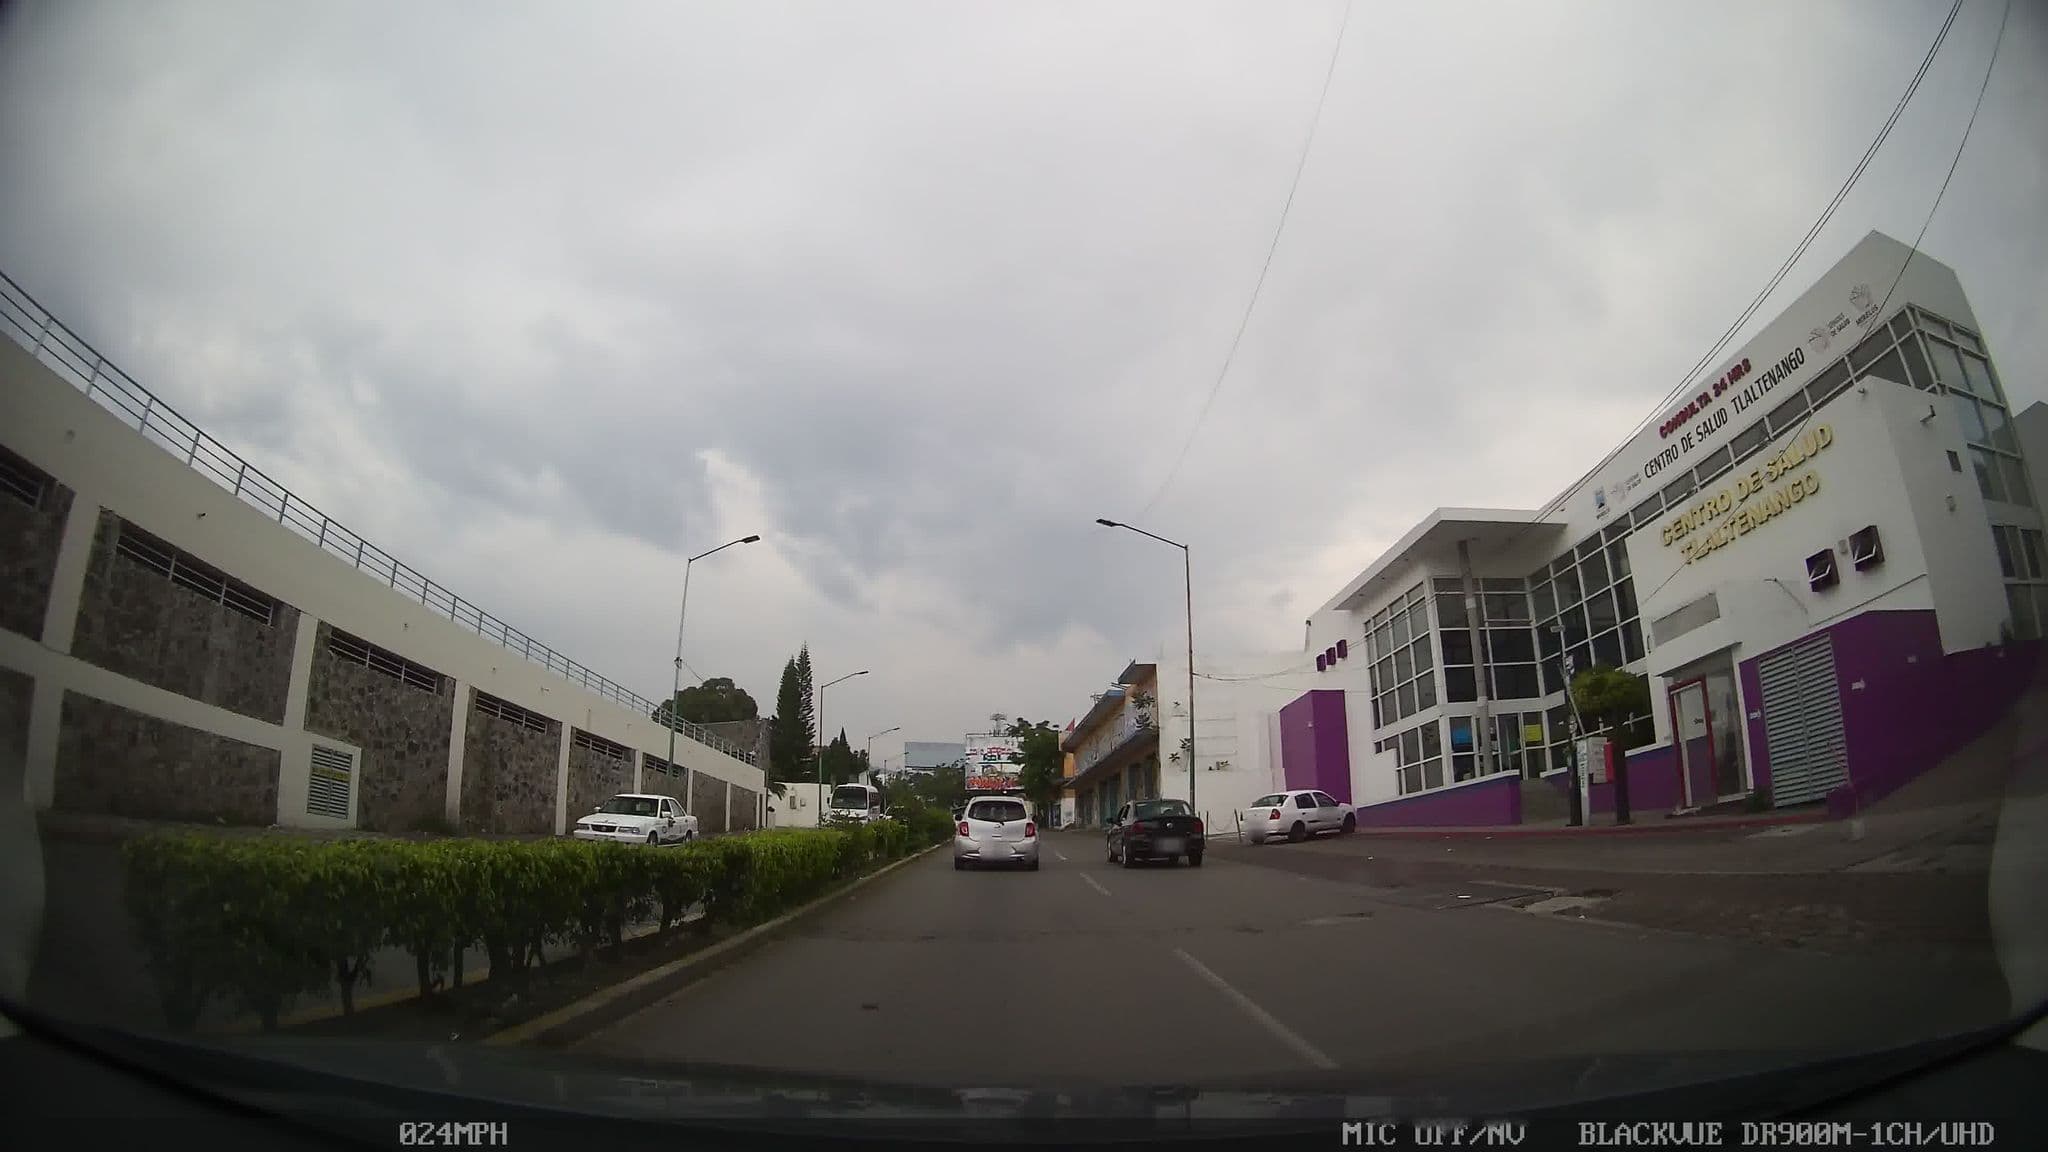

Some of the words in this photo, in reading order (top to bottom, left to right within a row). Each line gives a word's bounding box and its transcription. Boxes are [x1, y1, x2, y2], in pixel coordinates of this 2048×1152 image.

[1644, 448, 1679, 478] CENTRO
[1680, 431, 1695, 453] DE
[1695, 407, 1728, 442] SALUD
[1731, 347, 1805, 414] TLALTENANGO
[1659, 392, 1712, 439] CONSULTA
[1712, 378, 1728, 398] 24
[1727, 358, 1752, 385] HRS
[1661, 488, 1732, 546] CENTRO
[1736, 470, 1763, 501] DE
[1767, 423, 1833, 482] SALUD
[1680, 470, 1820, 564] TLALTENANGO
